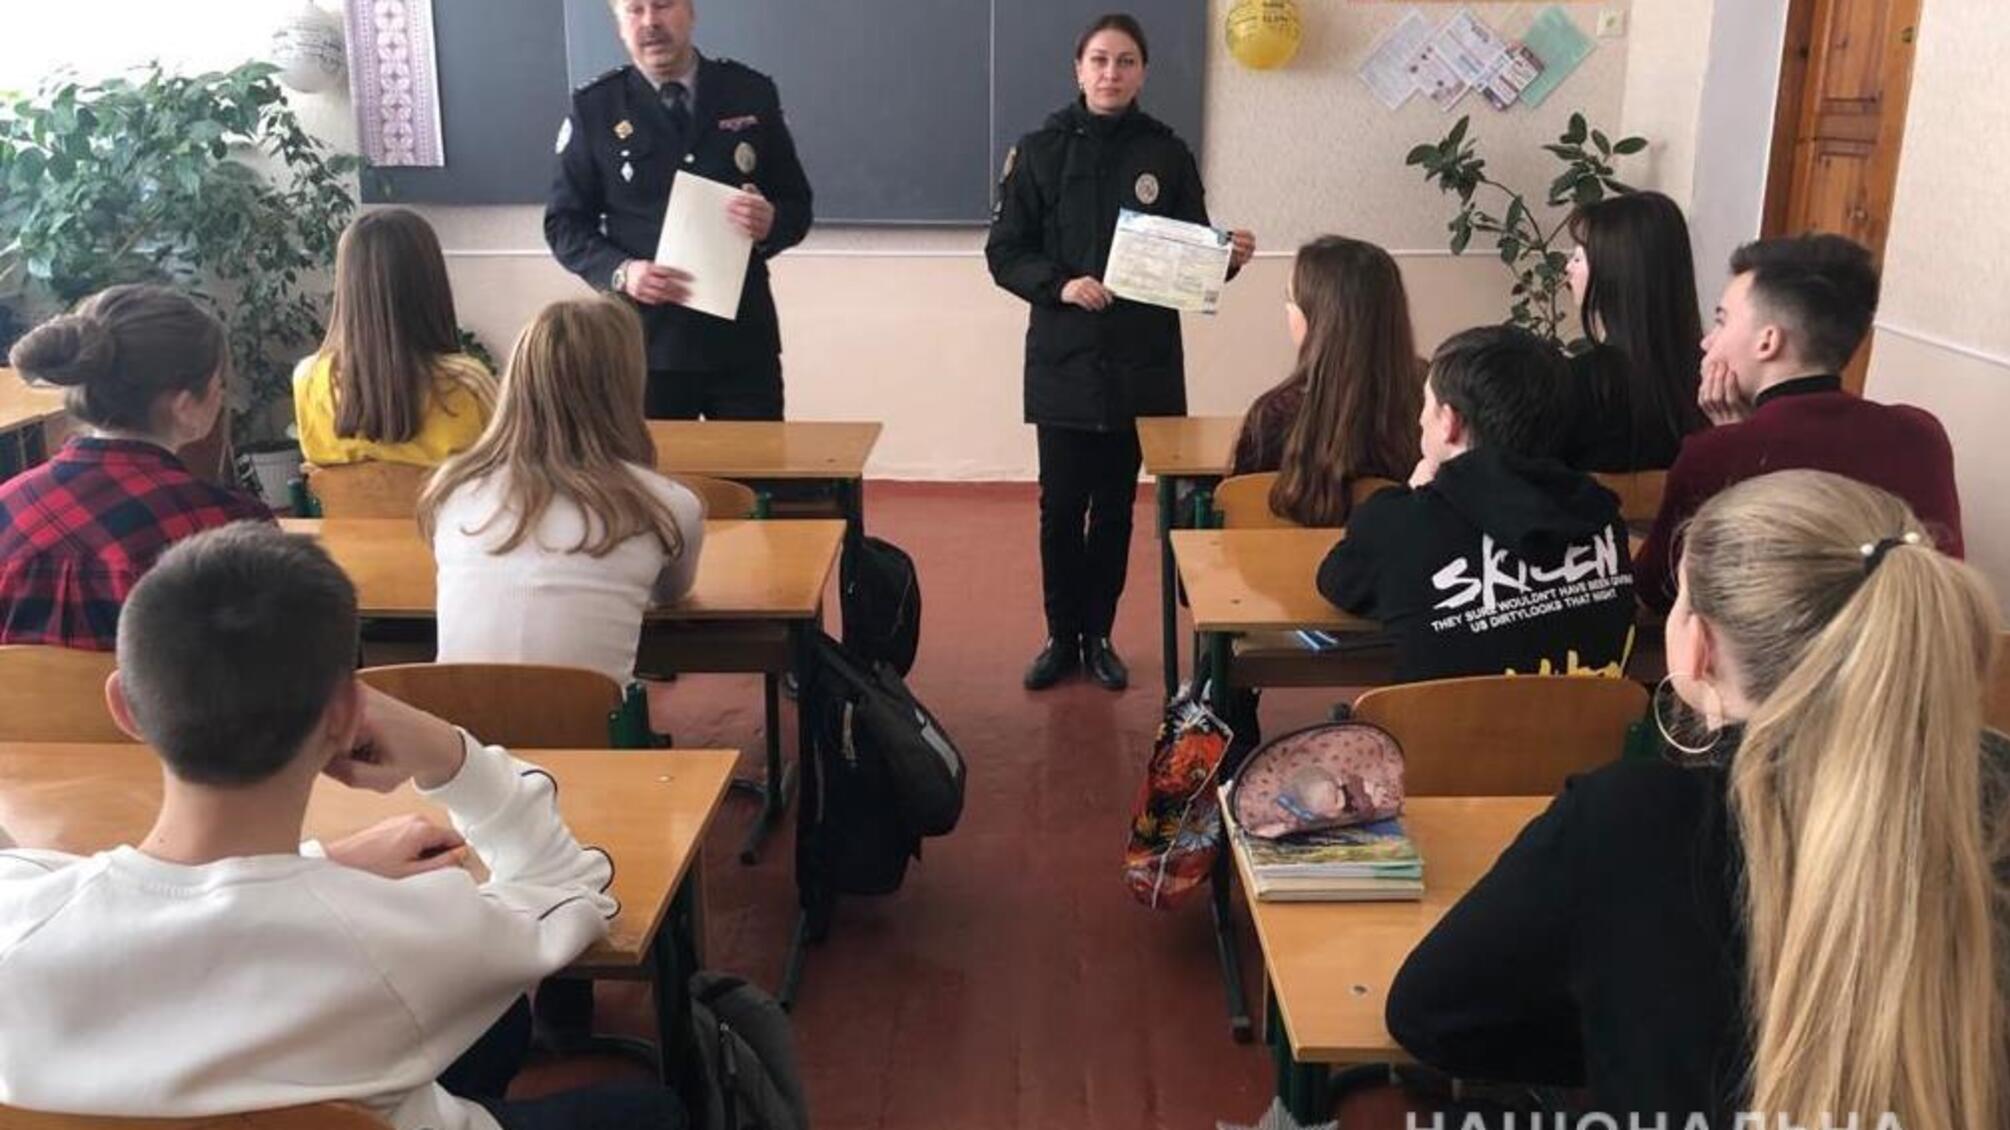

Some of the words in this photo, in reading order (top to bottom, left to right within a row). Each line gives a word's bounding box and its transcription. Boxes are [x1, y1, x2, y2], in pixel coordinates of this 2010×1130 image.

[1430, 613, 1463, 633] THEY
[1496, 588, 1557, 612] WOULDN'T
[1558, 580, 1588, 597] HAVE
[1469, 619, 1489, 633] US
[1563, 592, 1591, 608] THAT
